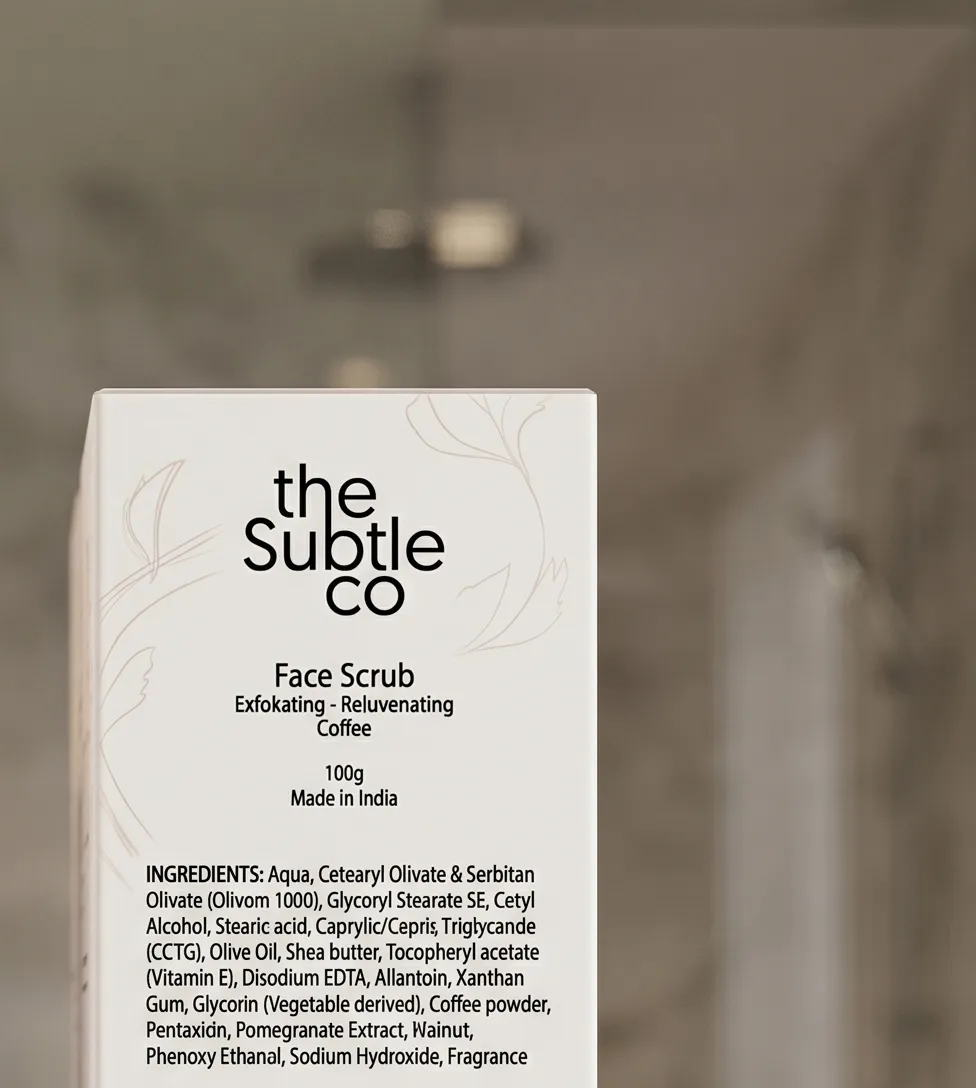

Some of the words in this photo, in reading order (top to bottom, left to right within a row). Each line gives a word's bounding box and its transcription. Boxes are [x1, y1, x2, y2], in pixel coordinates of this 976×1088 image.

[273, 462, 377, 519] the
[243, 516, 445, 572] Subtle
[325, 575, 405, 617] co
[275, 662, 333, 688] Face
[340, 661, 415, 688] Scrub
[316, 718, 372, 737] Coffee
[325, 764, 364, 786] 100g
[290, 788, 336, 807] Made
[339, 788, 354, 807] in
[359, 788, 398, 807] India
[146, 864, 264, 883] INGREDIENTS:
[267, 865, 315, 888] Aqua,
[318, 864, 385, 888] Cetearyl
[389, 864, 447, 884] Olivate
[450, 864, 463, 884] &
[466, 864, 535, 884] Serbitan
[145, 890, 203, 909] Olivate
[207, 890, 270, 912] (Olivom
[275, 890, 323, 912] 1000),
[326, 890, 392, 914] Glycoryl
[396, 891, 463, 909] Stearate
[467, 891, 490, 912] SE,
[493, 890, 535, 914] Cetyl
[146, 942, 206, 964] (CCTG),
[209, 942, 251, 961] Olive
[255, 941, 282, 964] Oil,
[285, 942, 325, 961] Shea
[329, 941, 383, 964] butter,
[385, 941, 476, 965] Tocopheryl
[480, 943, 540, 961] acetate
[146, 968, 214, 990] (Vitamin
[219, 968, 238, 989] E),
[242, 967, 320, 987] Disodium
[324, 968, 371, 989] EDTA,
[374, 967, 452, 989] Allantoin,
[456, 967, 524, 987] Xanthan
[145, 994, 189, 1016] Gum,
[192, 994, 259, 1018] Glycorin
[263, 994, 351, 1017] (Vegetable
[354, 994, 425, 1016] derived),
[429, 993, 482, 1013] Coffee
[485, 994, 551, 1017] powder,
[146, 1046, 217, 1070] Phenoxy
[289, 1046, 352, 1066] Sodium
[356, 1046, 444, 1070] Hydroxide,
[448, 1046, 528, 1070] Fragrance
